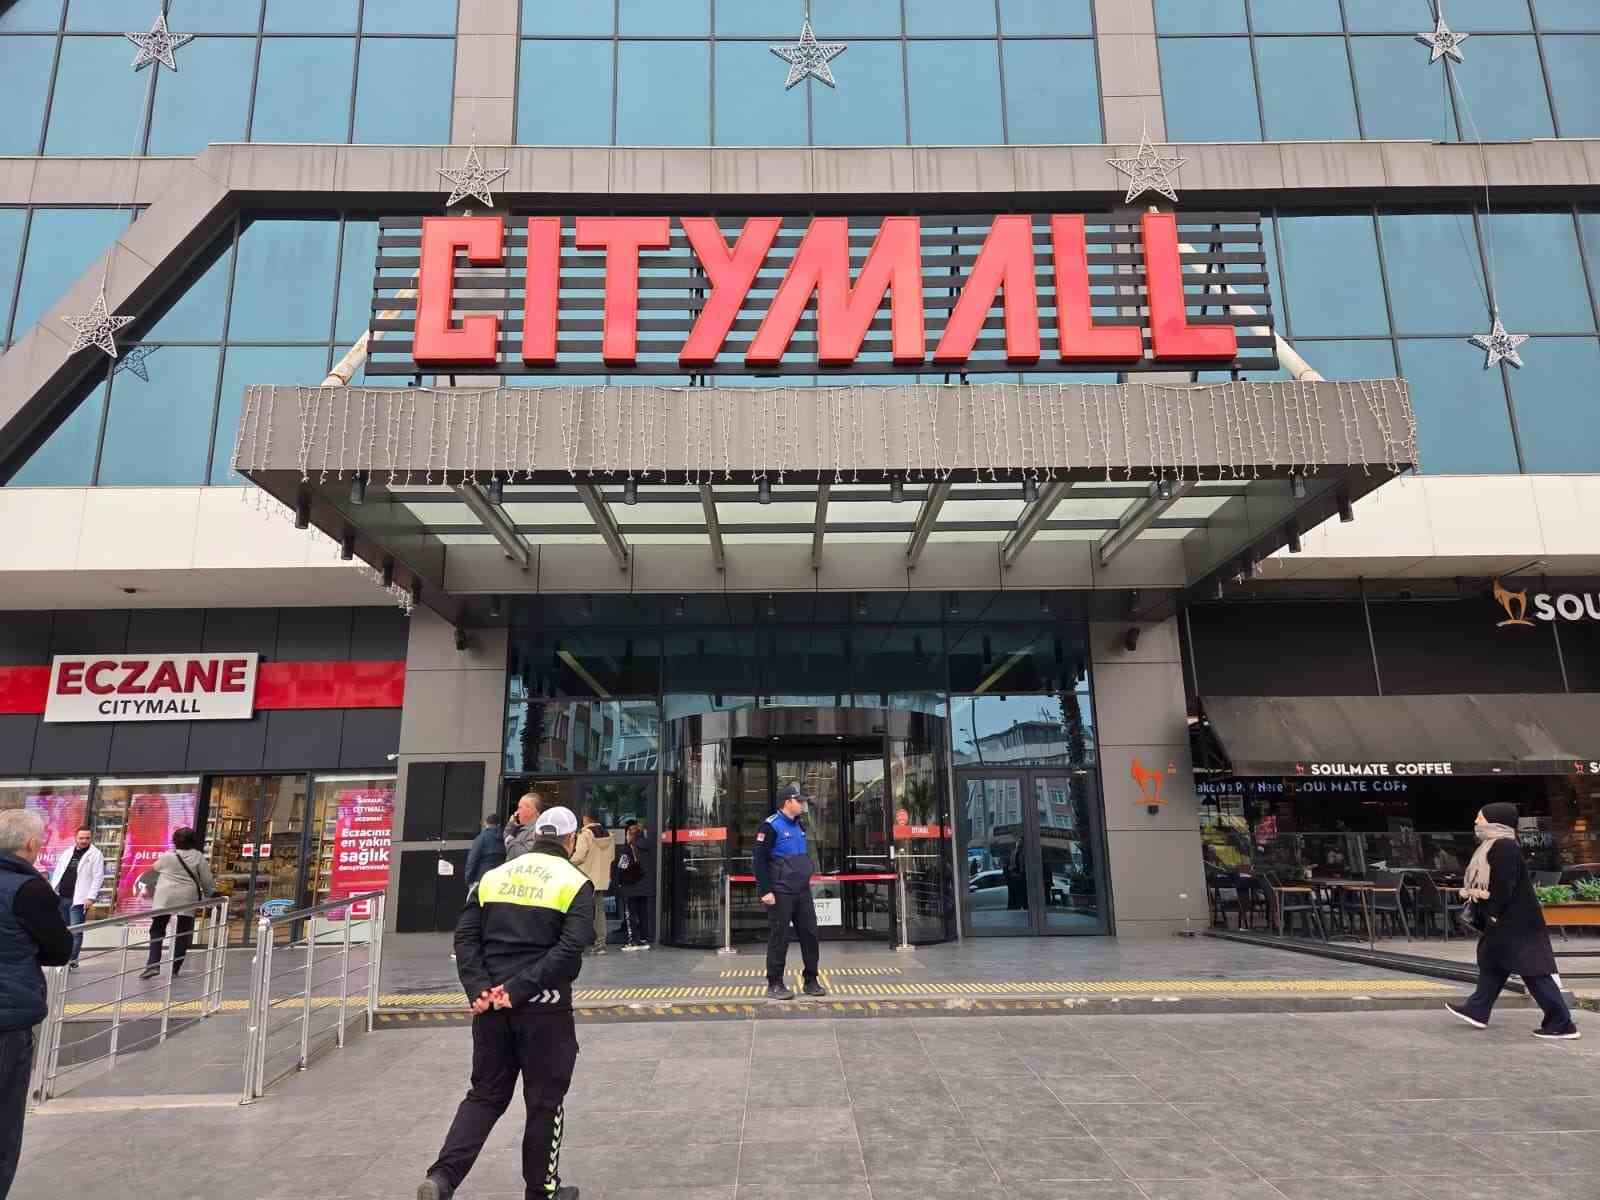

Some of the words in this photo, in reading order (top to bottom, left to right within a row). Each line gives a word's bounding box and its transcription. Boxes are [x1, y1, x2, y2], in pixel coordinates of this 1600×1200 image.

[412, 212, 1237, 365] CITYMALL
[56, 659, 248, 695] ECZANE
[98, 699, 201, 715] CITYMALL
[1311, 763, 1389, 776] SOULMATE
[1395, 762, 1453, 775] COFFEE
[341, 839, 356, 848] en
[339, 848, 390, 865] sağlık
[498, 882, 544, 899] ZABITA
